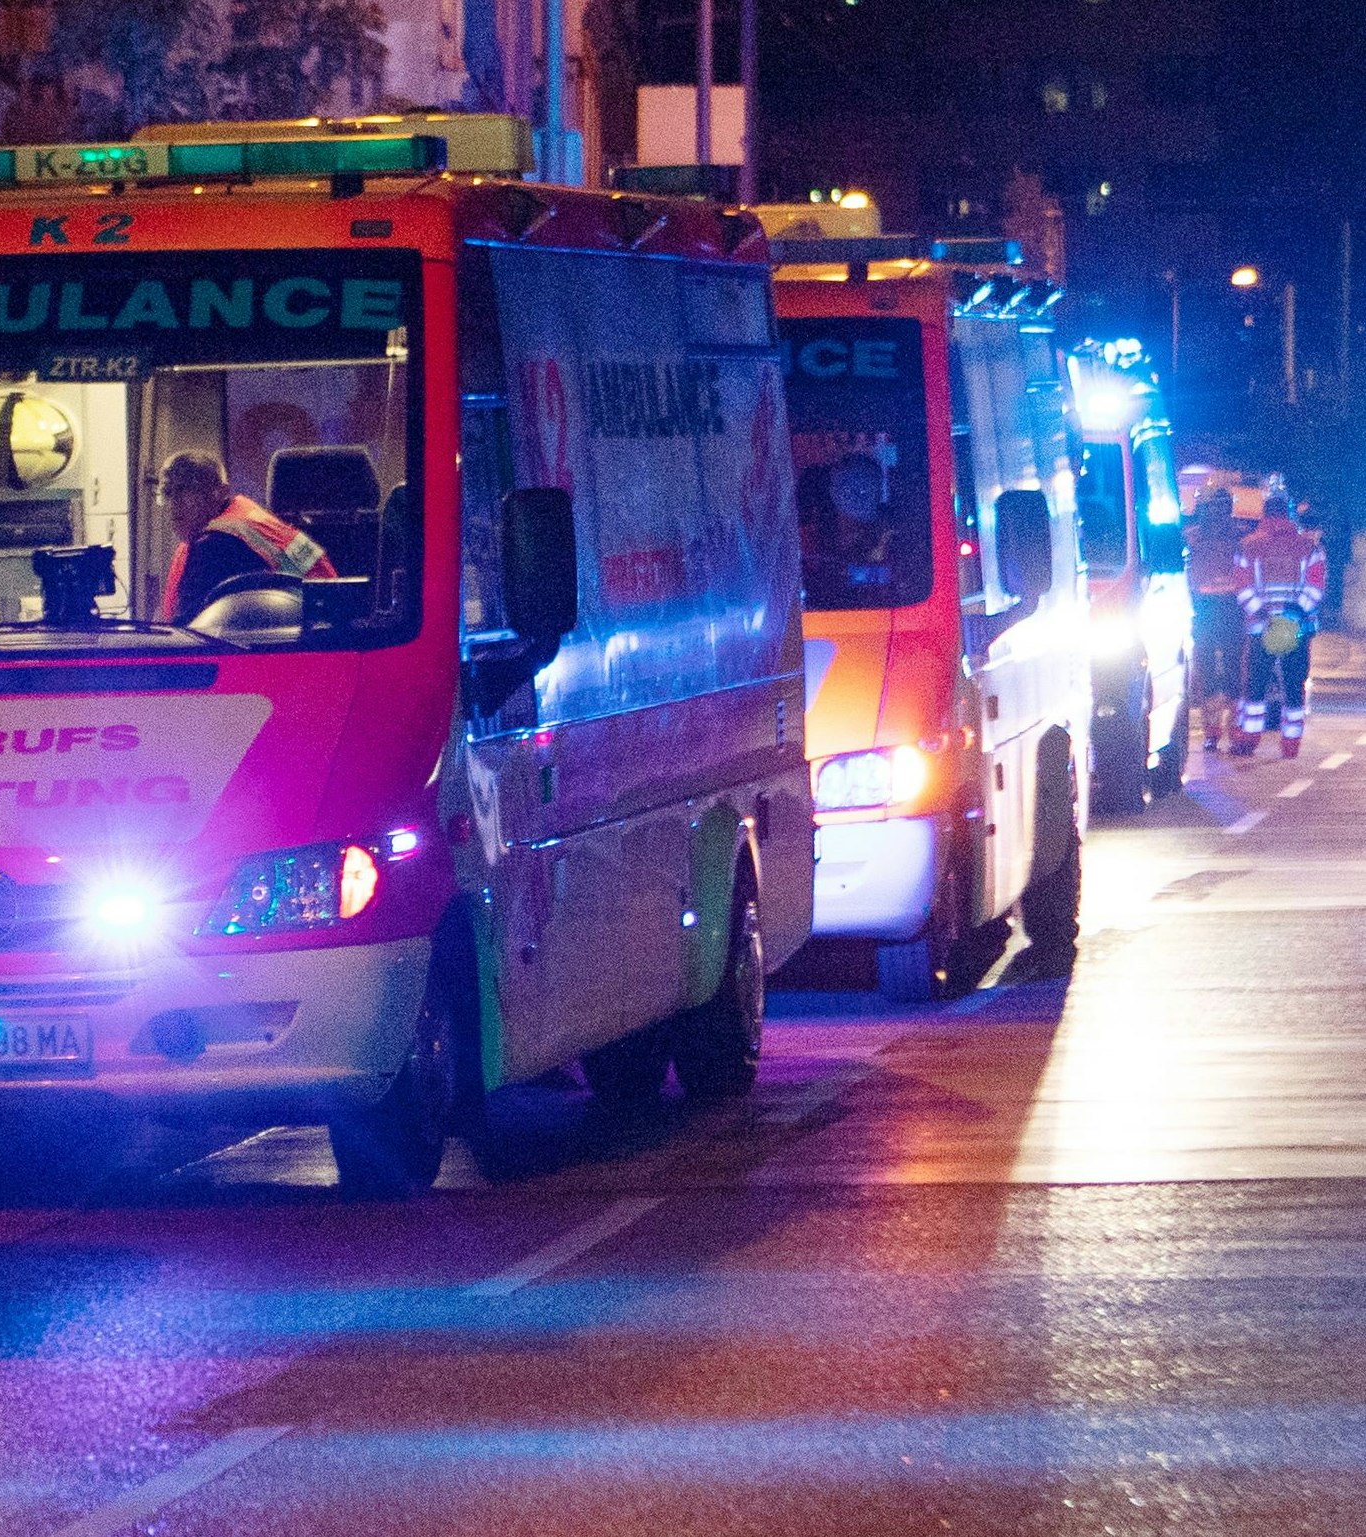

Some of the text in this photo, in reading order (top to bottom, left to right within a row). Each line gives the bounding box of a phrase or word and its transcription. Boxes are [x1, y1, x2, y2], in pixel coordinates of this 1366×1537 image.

[30, 212, 134, 245] K 2
[49, 354, 141, 379] ZTR-K2
